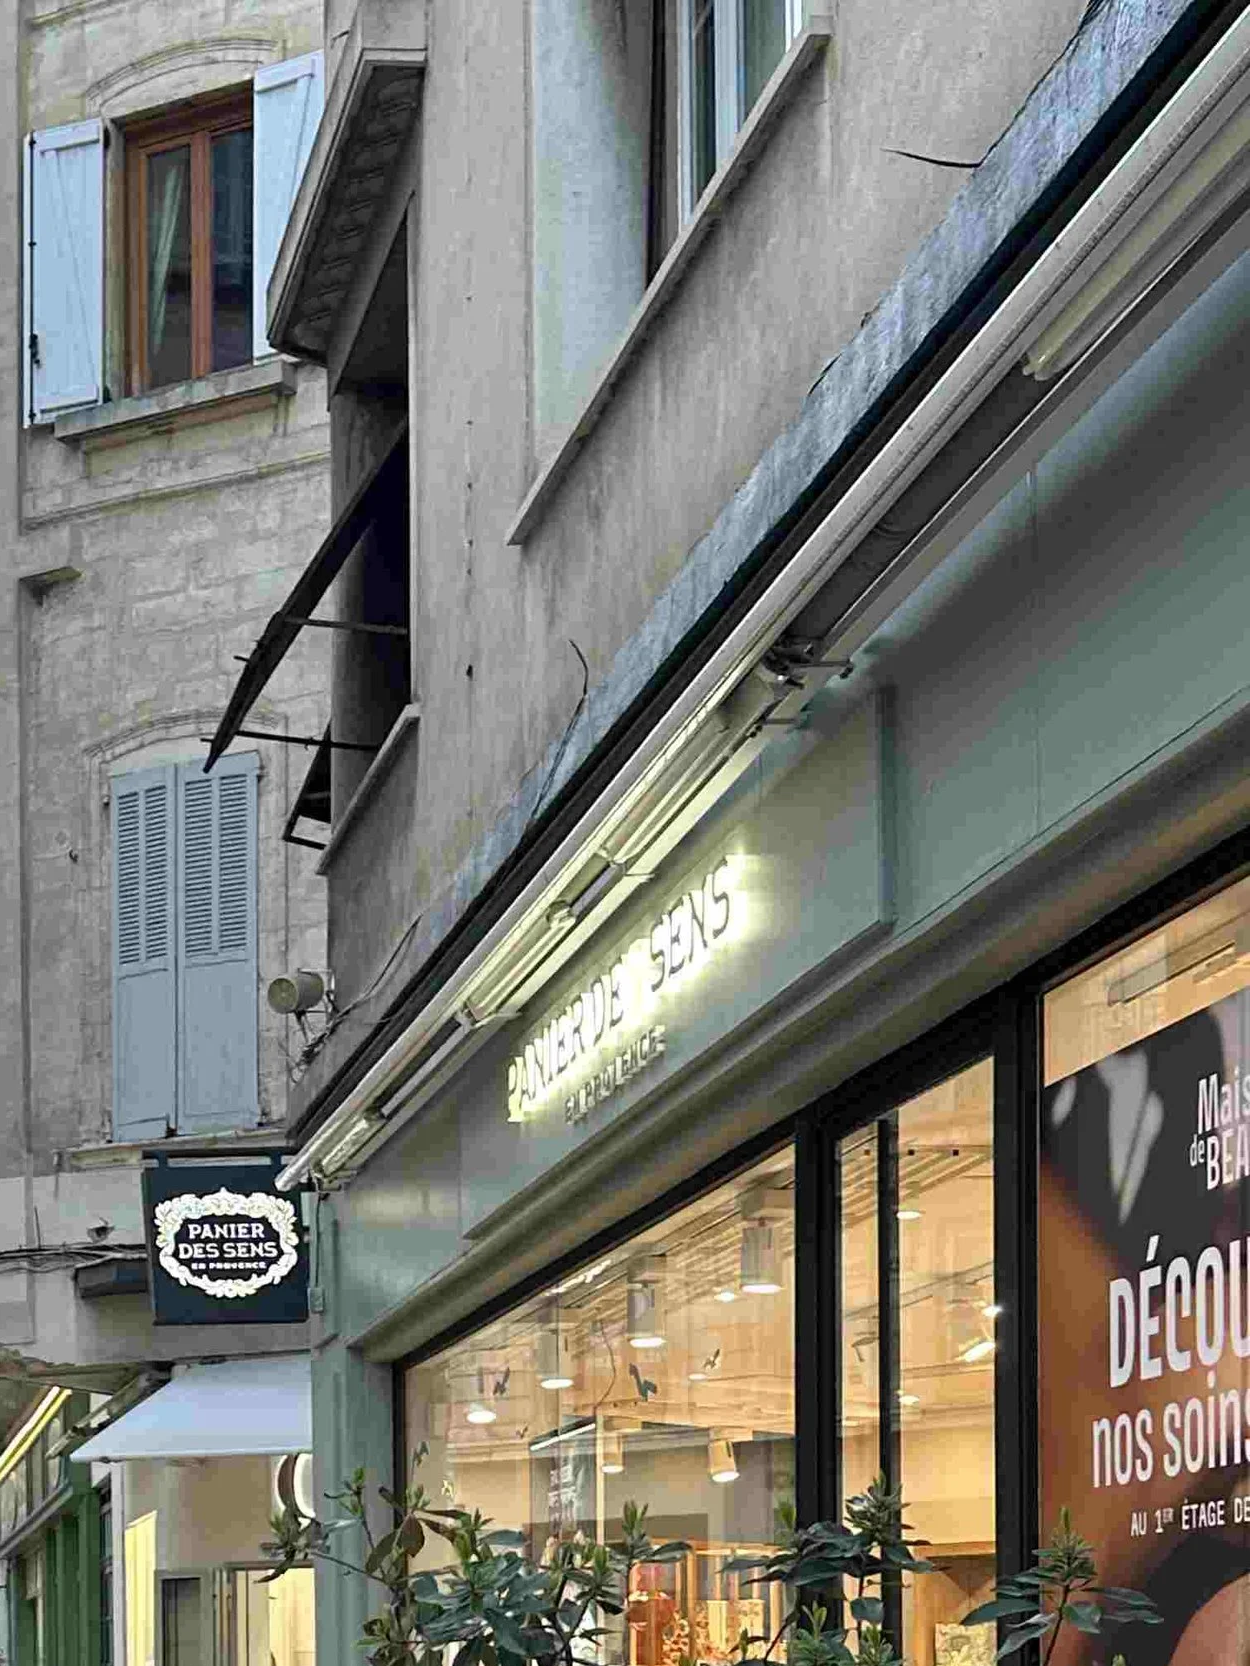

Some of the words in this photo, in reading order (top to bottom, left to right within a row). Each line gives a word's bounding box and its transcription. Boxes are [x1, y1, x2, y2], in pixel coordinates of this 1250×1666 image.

[651, 857, 731, 992] SENS
[1190, 1134, 1205, 1166] de
[1207, 1124, 1250, 1190] BEA
[178, 1243, 219, 1259] DES
[223, 1242, 278, 1258] SENS
[188, 1223, 265, 1239] PANIER
[1110, 1234, 1250, 1388] DÉCOU
[1092, 1409, 1153, 1488] nos
[1163, 1370, 1250, 1477] soin
[1131, 1511, 1147, 1536] AU
[1182, 1498, 1226, 1530] ÉTAGE
